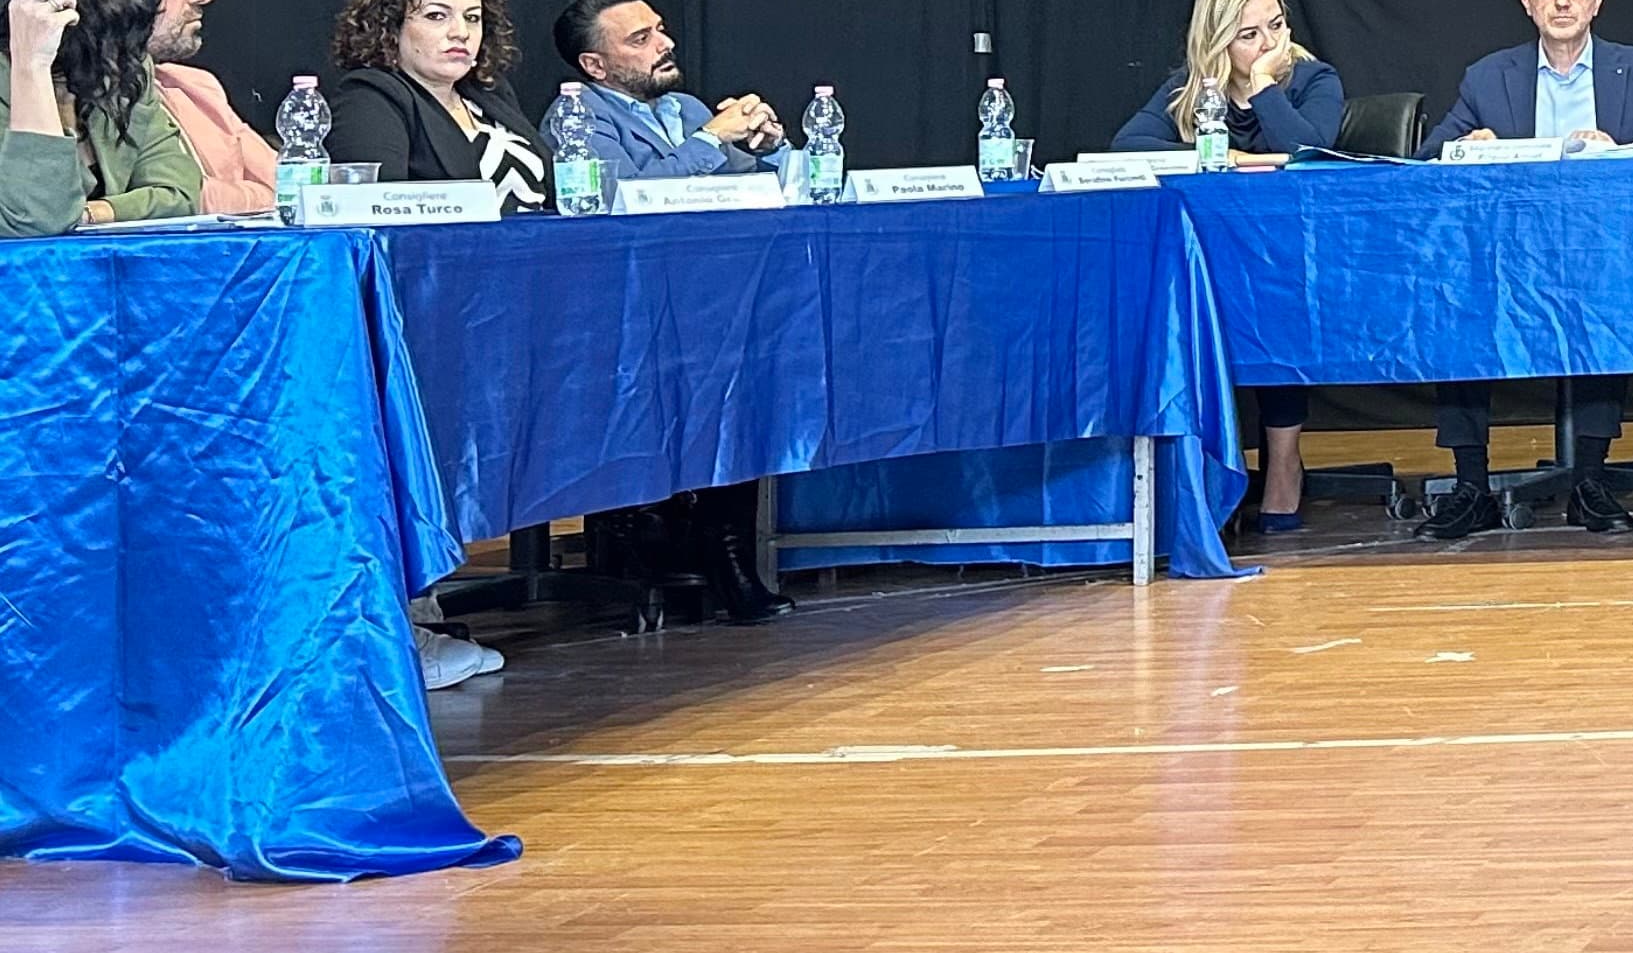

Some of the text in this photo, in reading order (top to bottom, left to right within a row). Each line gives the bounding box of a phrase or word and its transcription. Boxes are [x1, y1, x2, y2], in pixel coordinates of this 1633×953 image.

[891, 183, 965, 194] Paola Marino
[383, 191, 448, 202] Consigliere
[371, 203, 464, 216] Rosa Turco
